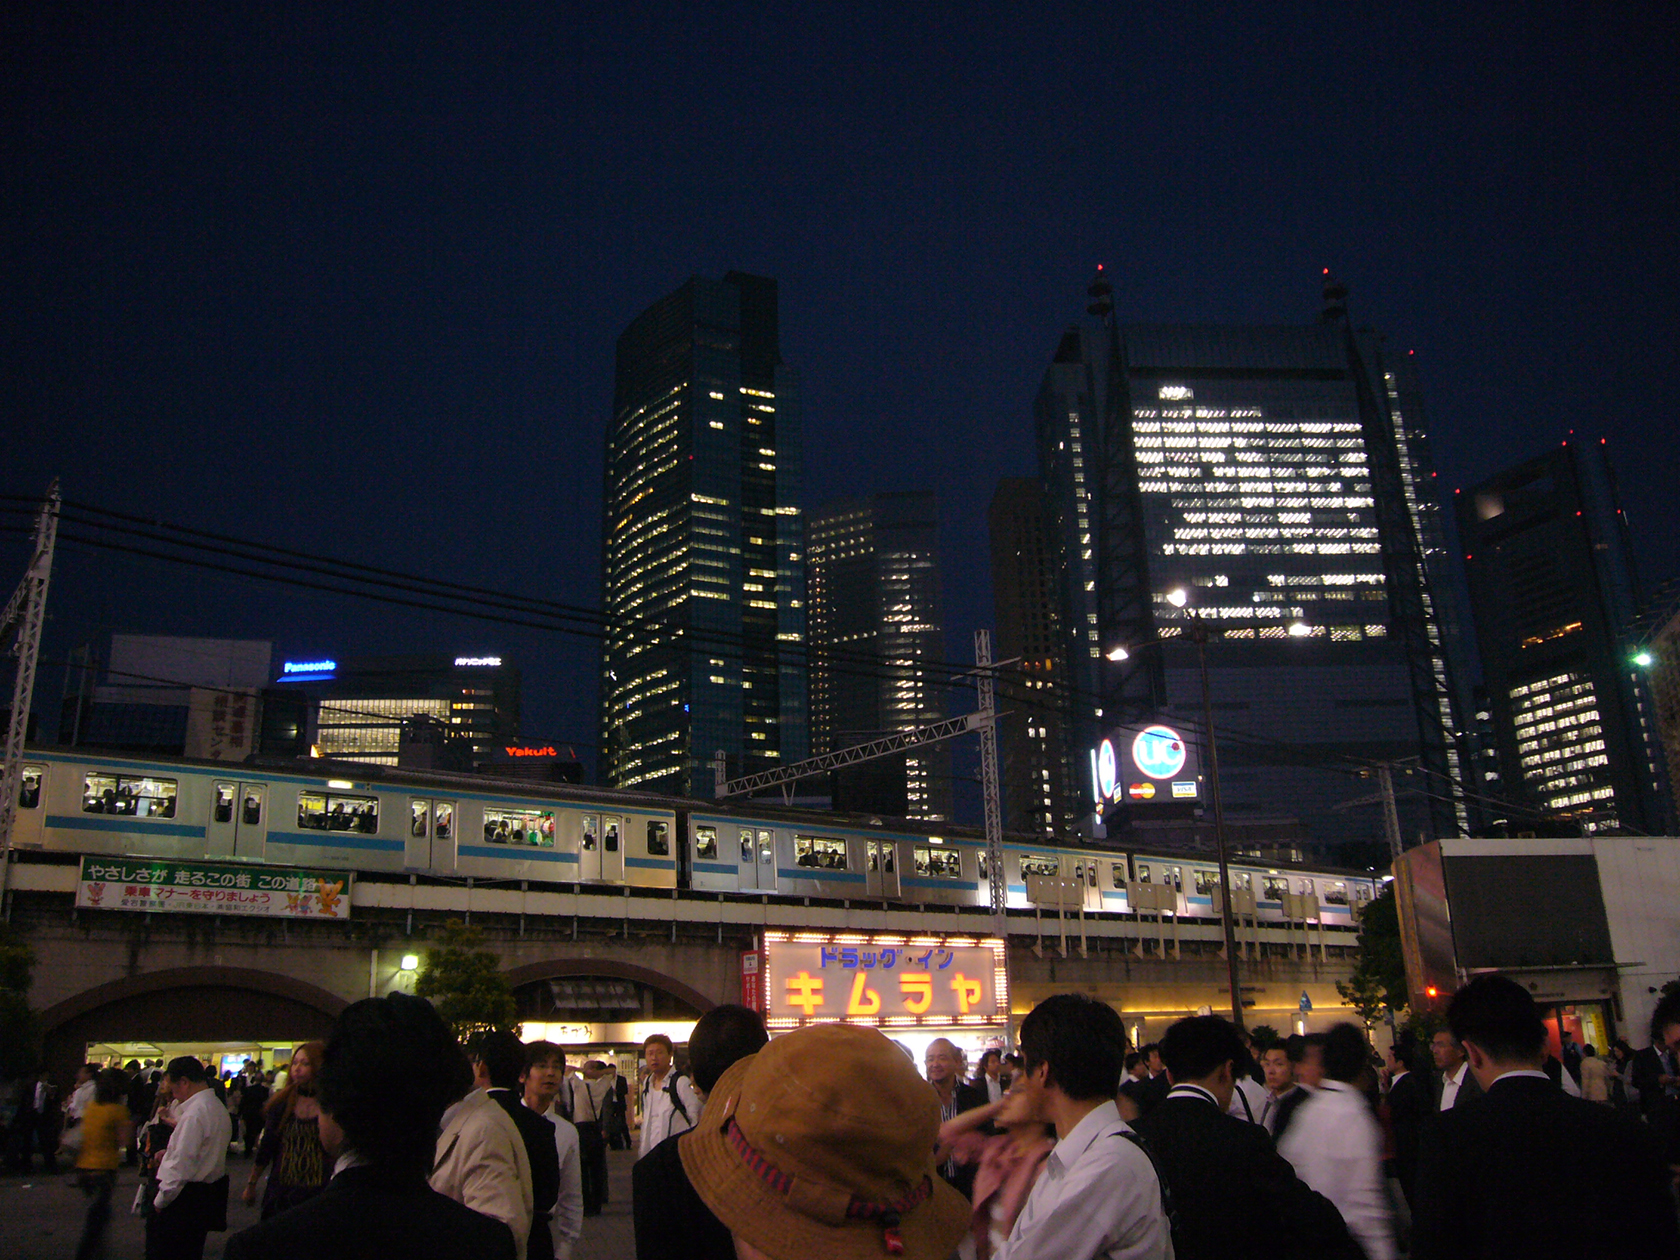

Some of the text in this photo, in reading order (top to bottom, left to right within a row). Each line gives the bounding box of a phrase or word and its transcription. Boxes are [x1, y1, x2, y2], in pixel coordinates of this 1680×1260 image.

[284, 660, 336, 673] Panasonic
[505, 746, 557, 757] Yakult
[87, 864, 168, 883] やさしさが
[174, 870, 251, 889] 走るこの街
[124, 885, 271, 903] 乗車マナーを守りましょう
[820, 946, 954, 970] ドラッグ・イン
[786, 970, 982, 1016] キムラヤ
